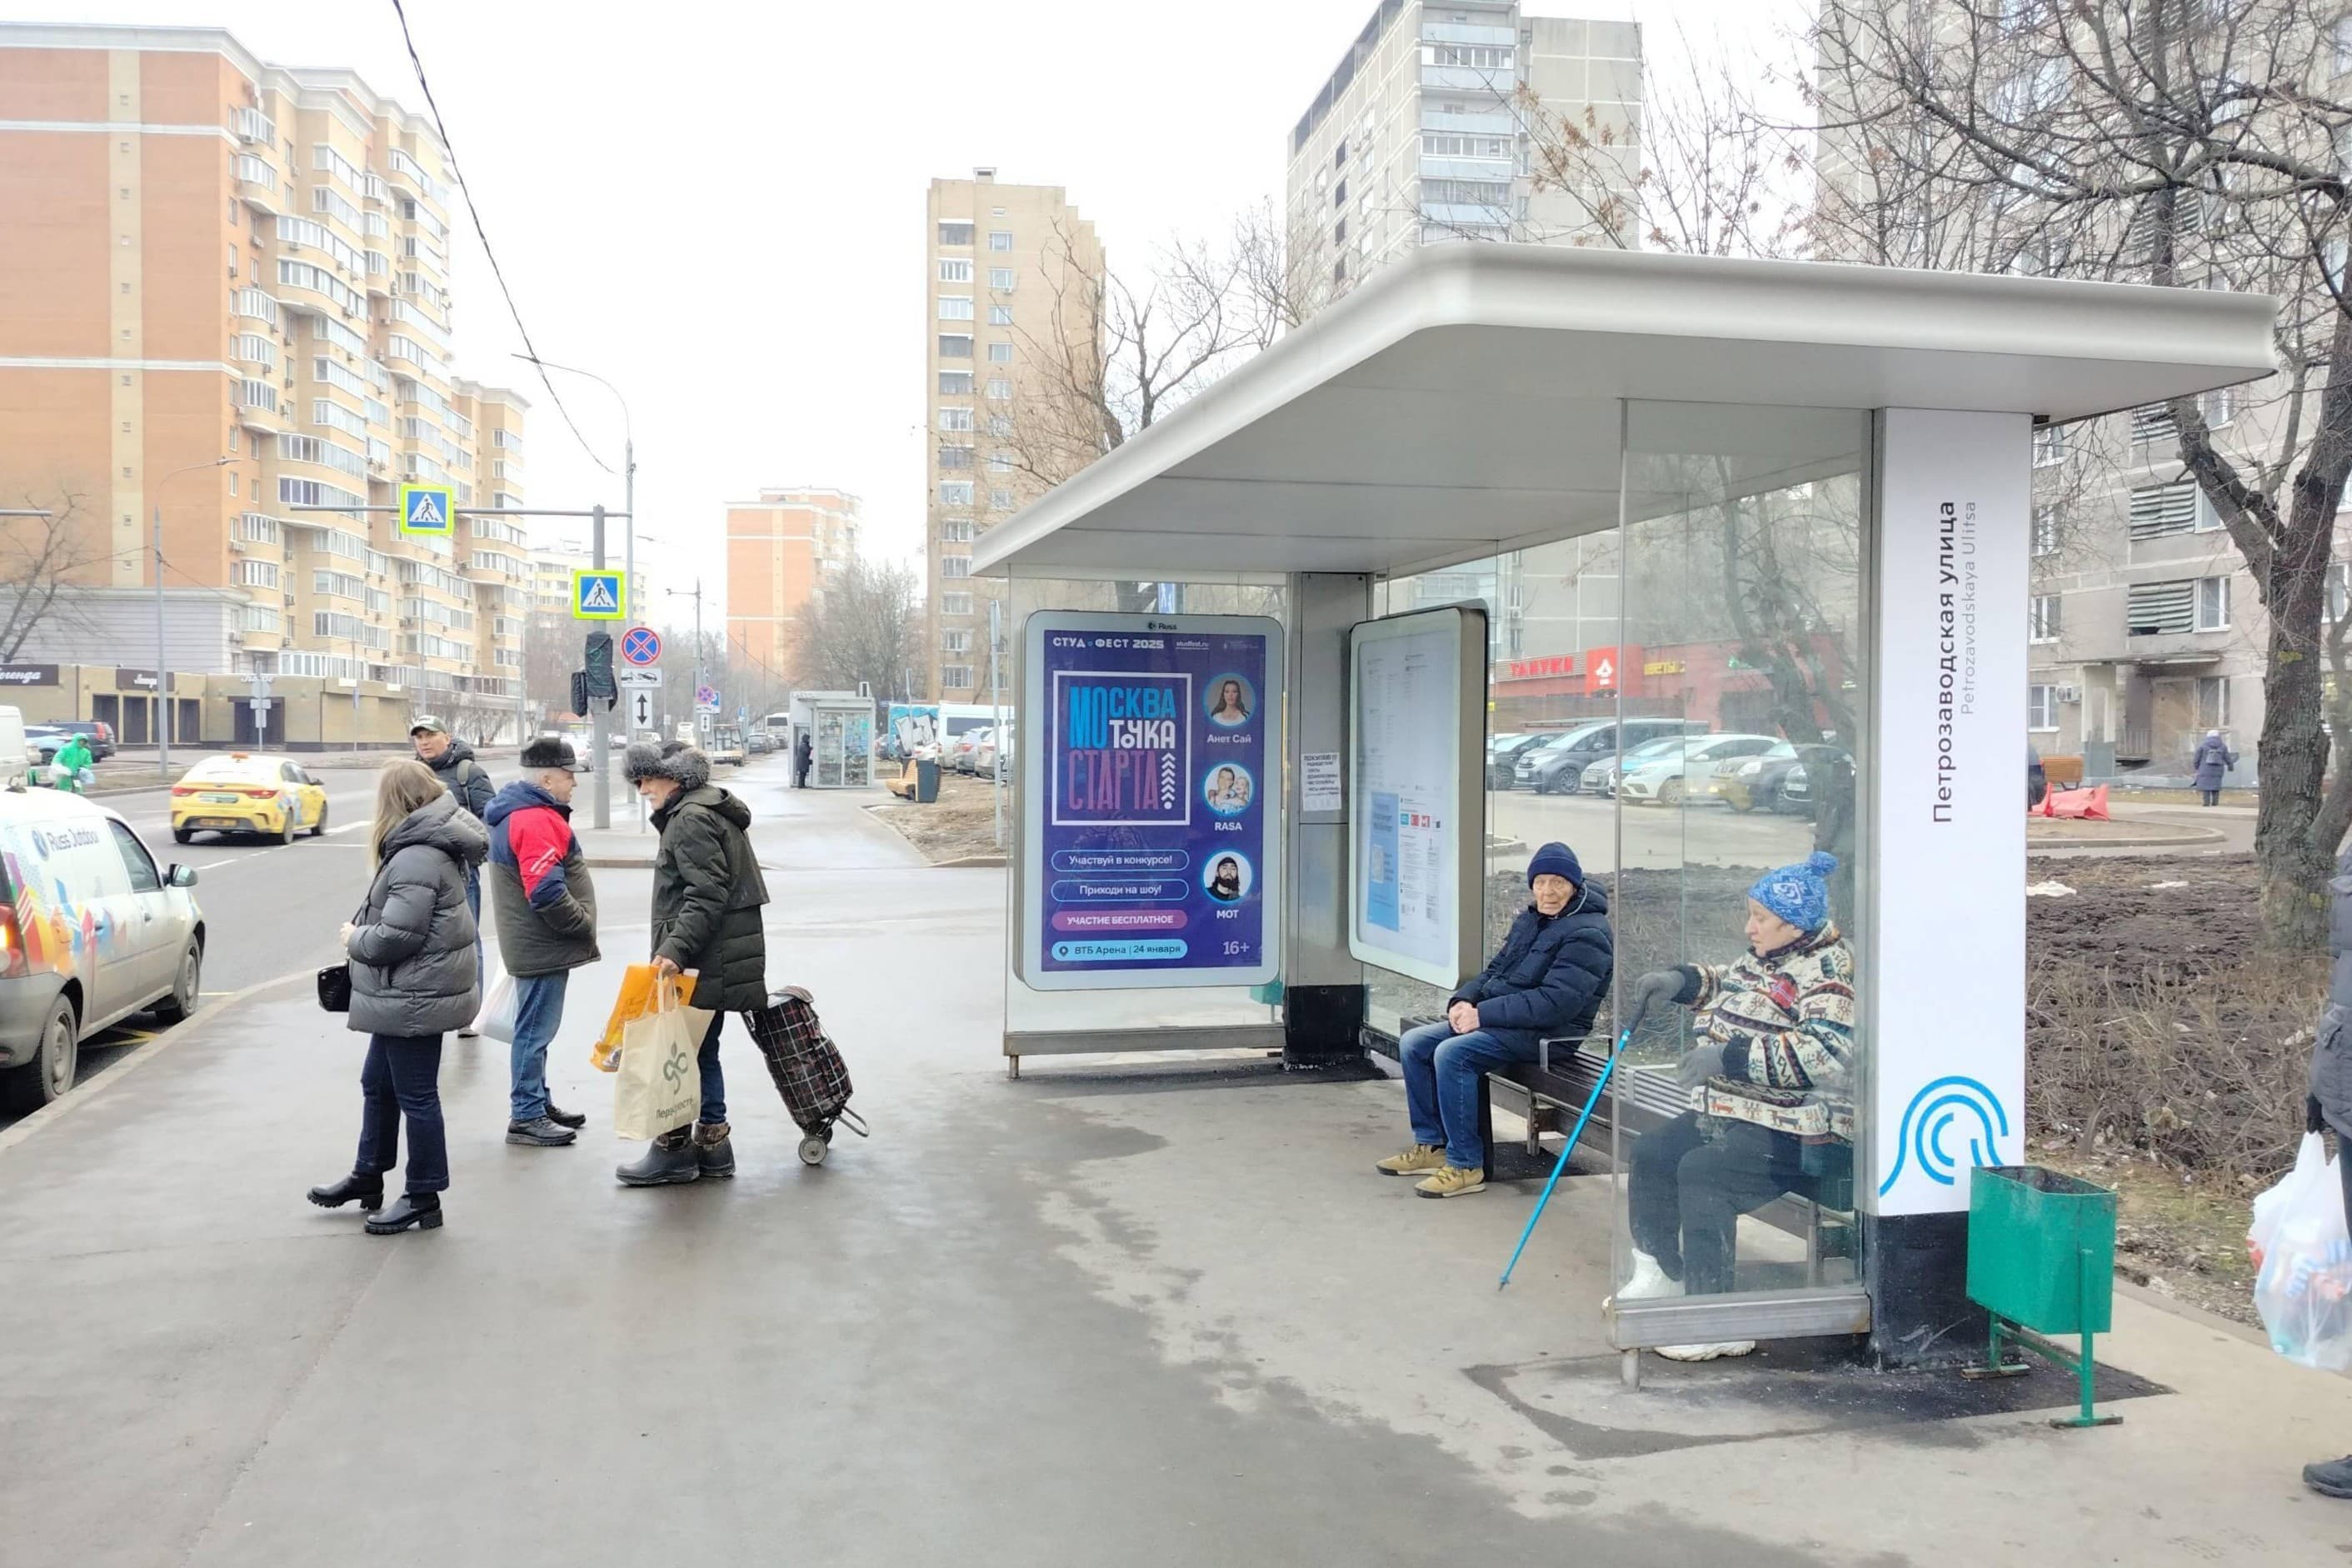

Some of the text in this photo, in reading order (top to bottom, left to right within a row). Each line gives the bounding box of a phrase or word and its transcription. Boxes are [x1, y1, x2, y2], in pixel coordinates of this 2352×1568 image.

[1961, 502, 1979, 715] Petrozavodskaya Ulitsa
[1052, 637, 1164, 649] СТУД ФЕСТ 2025
[1933, 502, 1959, 823] Петрозаводская улица
[1069, 686, 1176, 749] МОСКВА
[1206, 734, 1252, 743] Анет Сай
[1068, 750, 1159, 810] СТАРТА
[1215, 821, 1242, 831] RASA
[1069, 856, 1114, 867] Участвуй
[1124, 855, 1172, 866] конкурсе!
[1080, 886, 1123, 896] Приходи
[1140, 885, 1162, 896] шоу!
[1216, 910, 1239, 919] МОТ
[1067, 916, 1173, 926] УЧАСТИЕ БЕСПЛАТНОЕ
[1096, 946, 1126, 956] Арена
[1133, 945, 1144, 953] 24
[1146, 946, 1181, 954] января
[1223, 941, 1251, 955] 16+
